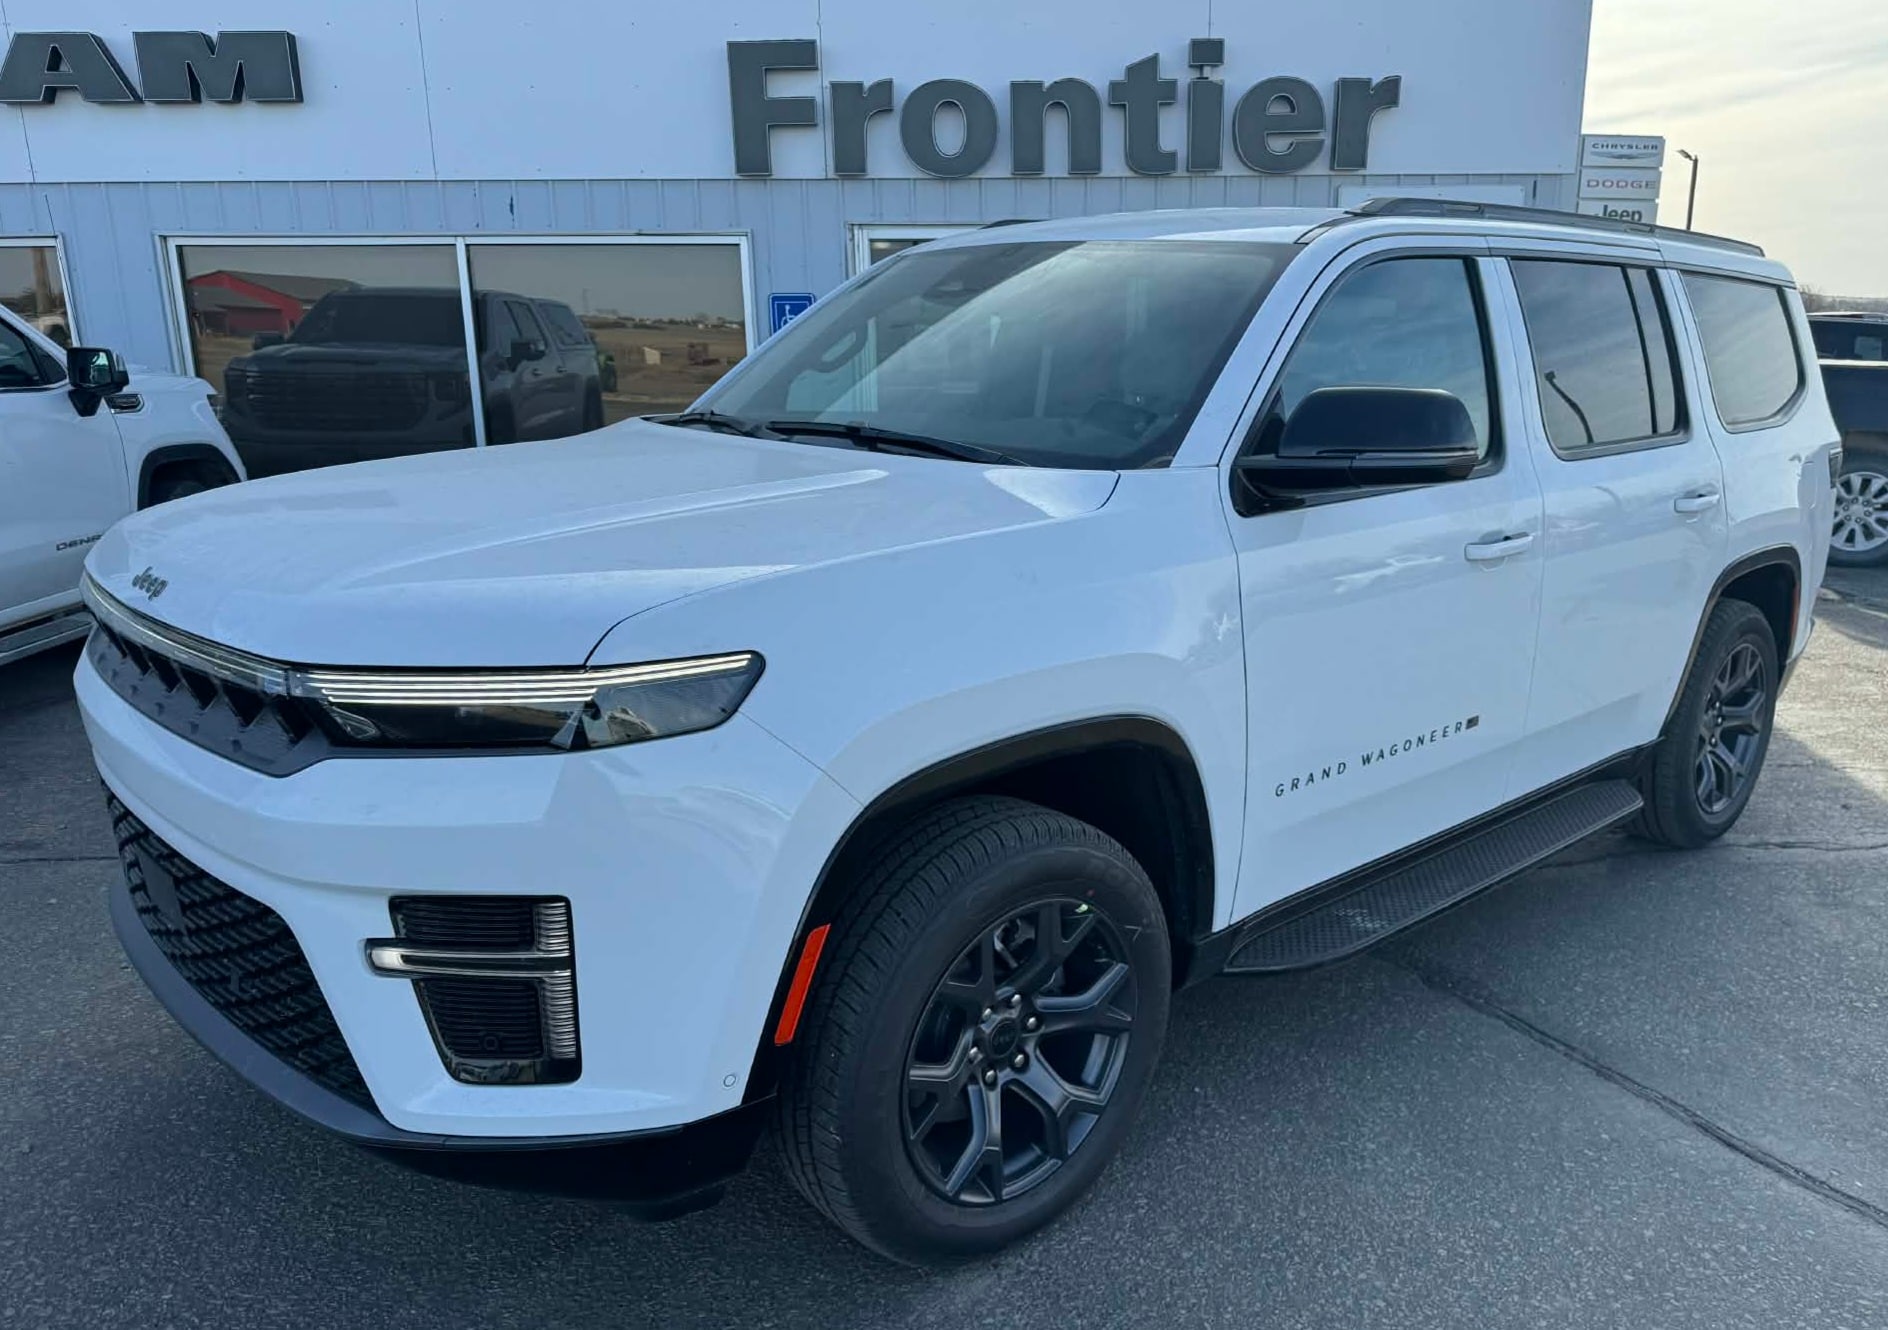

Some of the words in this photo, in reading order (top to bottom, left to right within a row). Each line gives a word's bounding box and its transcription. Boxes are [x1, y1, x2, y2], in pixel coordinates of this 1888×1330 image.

[726, 38, 1401, 178] Frontier
[1591, 143, 1659, 151] CHRYSLER
[1586, 179, 1657, 190] DODGE
[131, 566, 168, 601] Jeep
[1274, 762, 1348, 798] GRAND
[1361, 721, 1463, 767] WAGONEER
